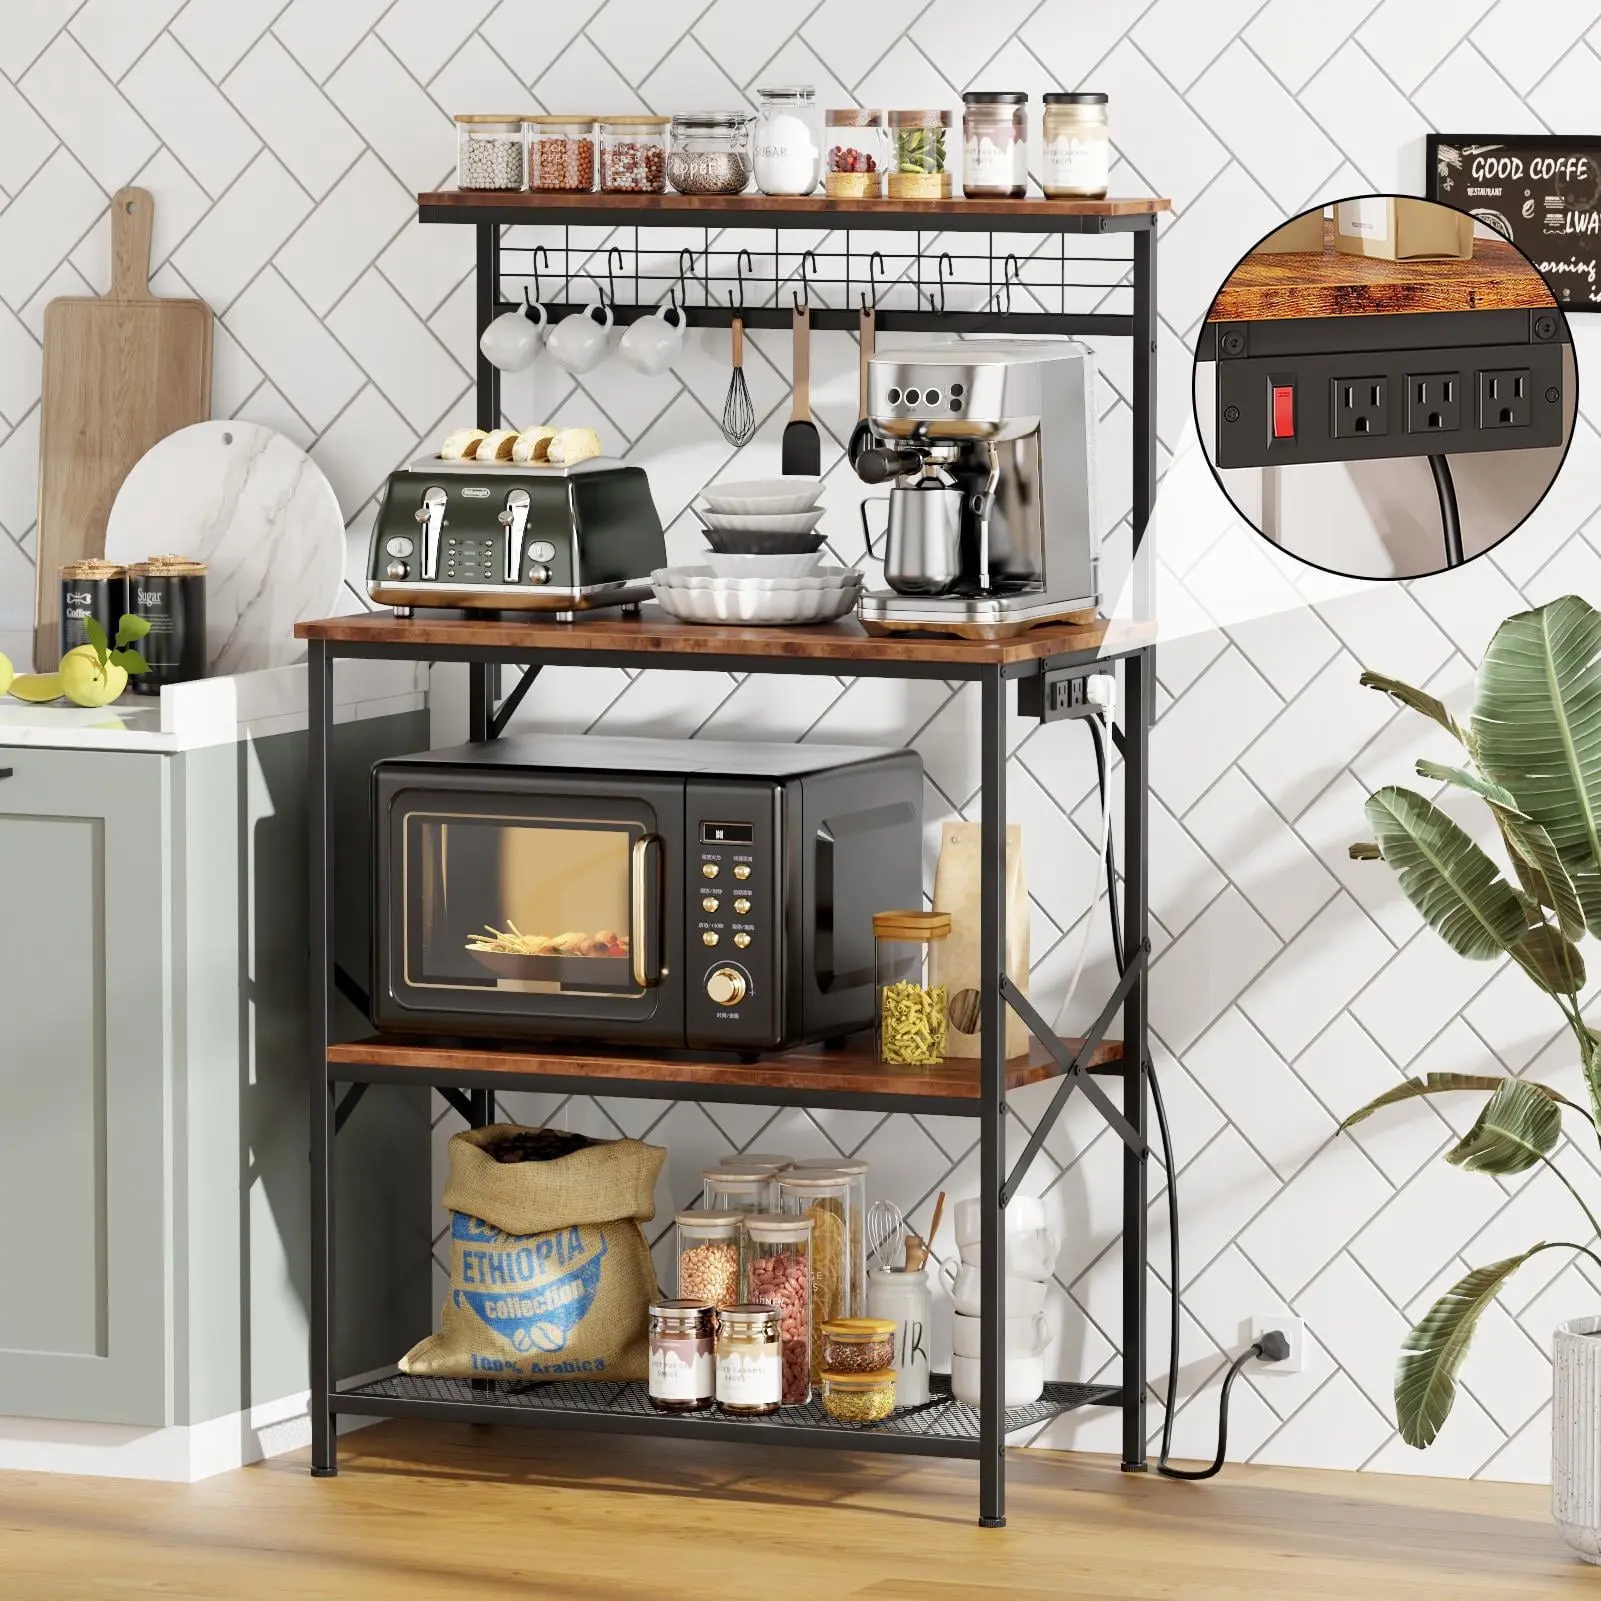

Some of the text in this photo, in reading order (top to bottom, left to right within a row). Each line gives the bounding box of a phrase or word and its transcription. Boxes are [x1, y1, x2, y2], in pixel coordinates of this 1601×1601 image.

[1472, 157, 1588, 182] GOOD COFFE
[1467, 187, 1503, 196] RESTAURANT
[1565, 210, 1601, 235] LWA
[1533, 256, 1596, 283] orning
[137, 587, 162, 607] Sugar
[66, 608, 92, 618] Coffee
[462, 1225, 586, 1285] ETHIOPIA
[472, 1353, 606, 1374] 100% Arabica
